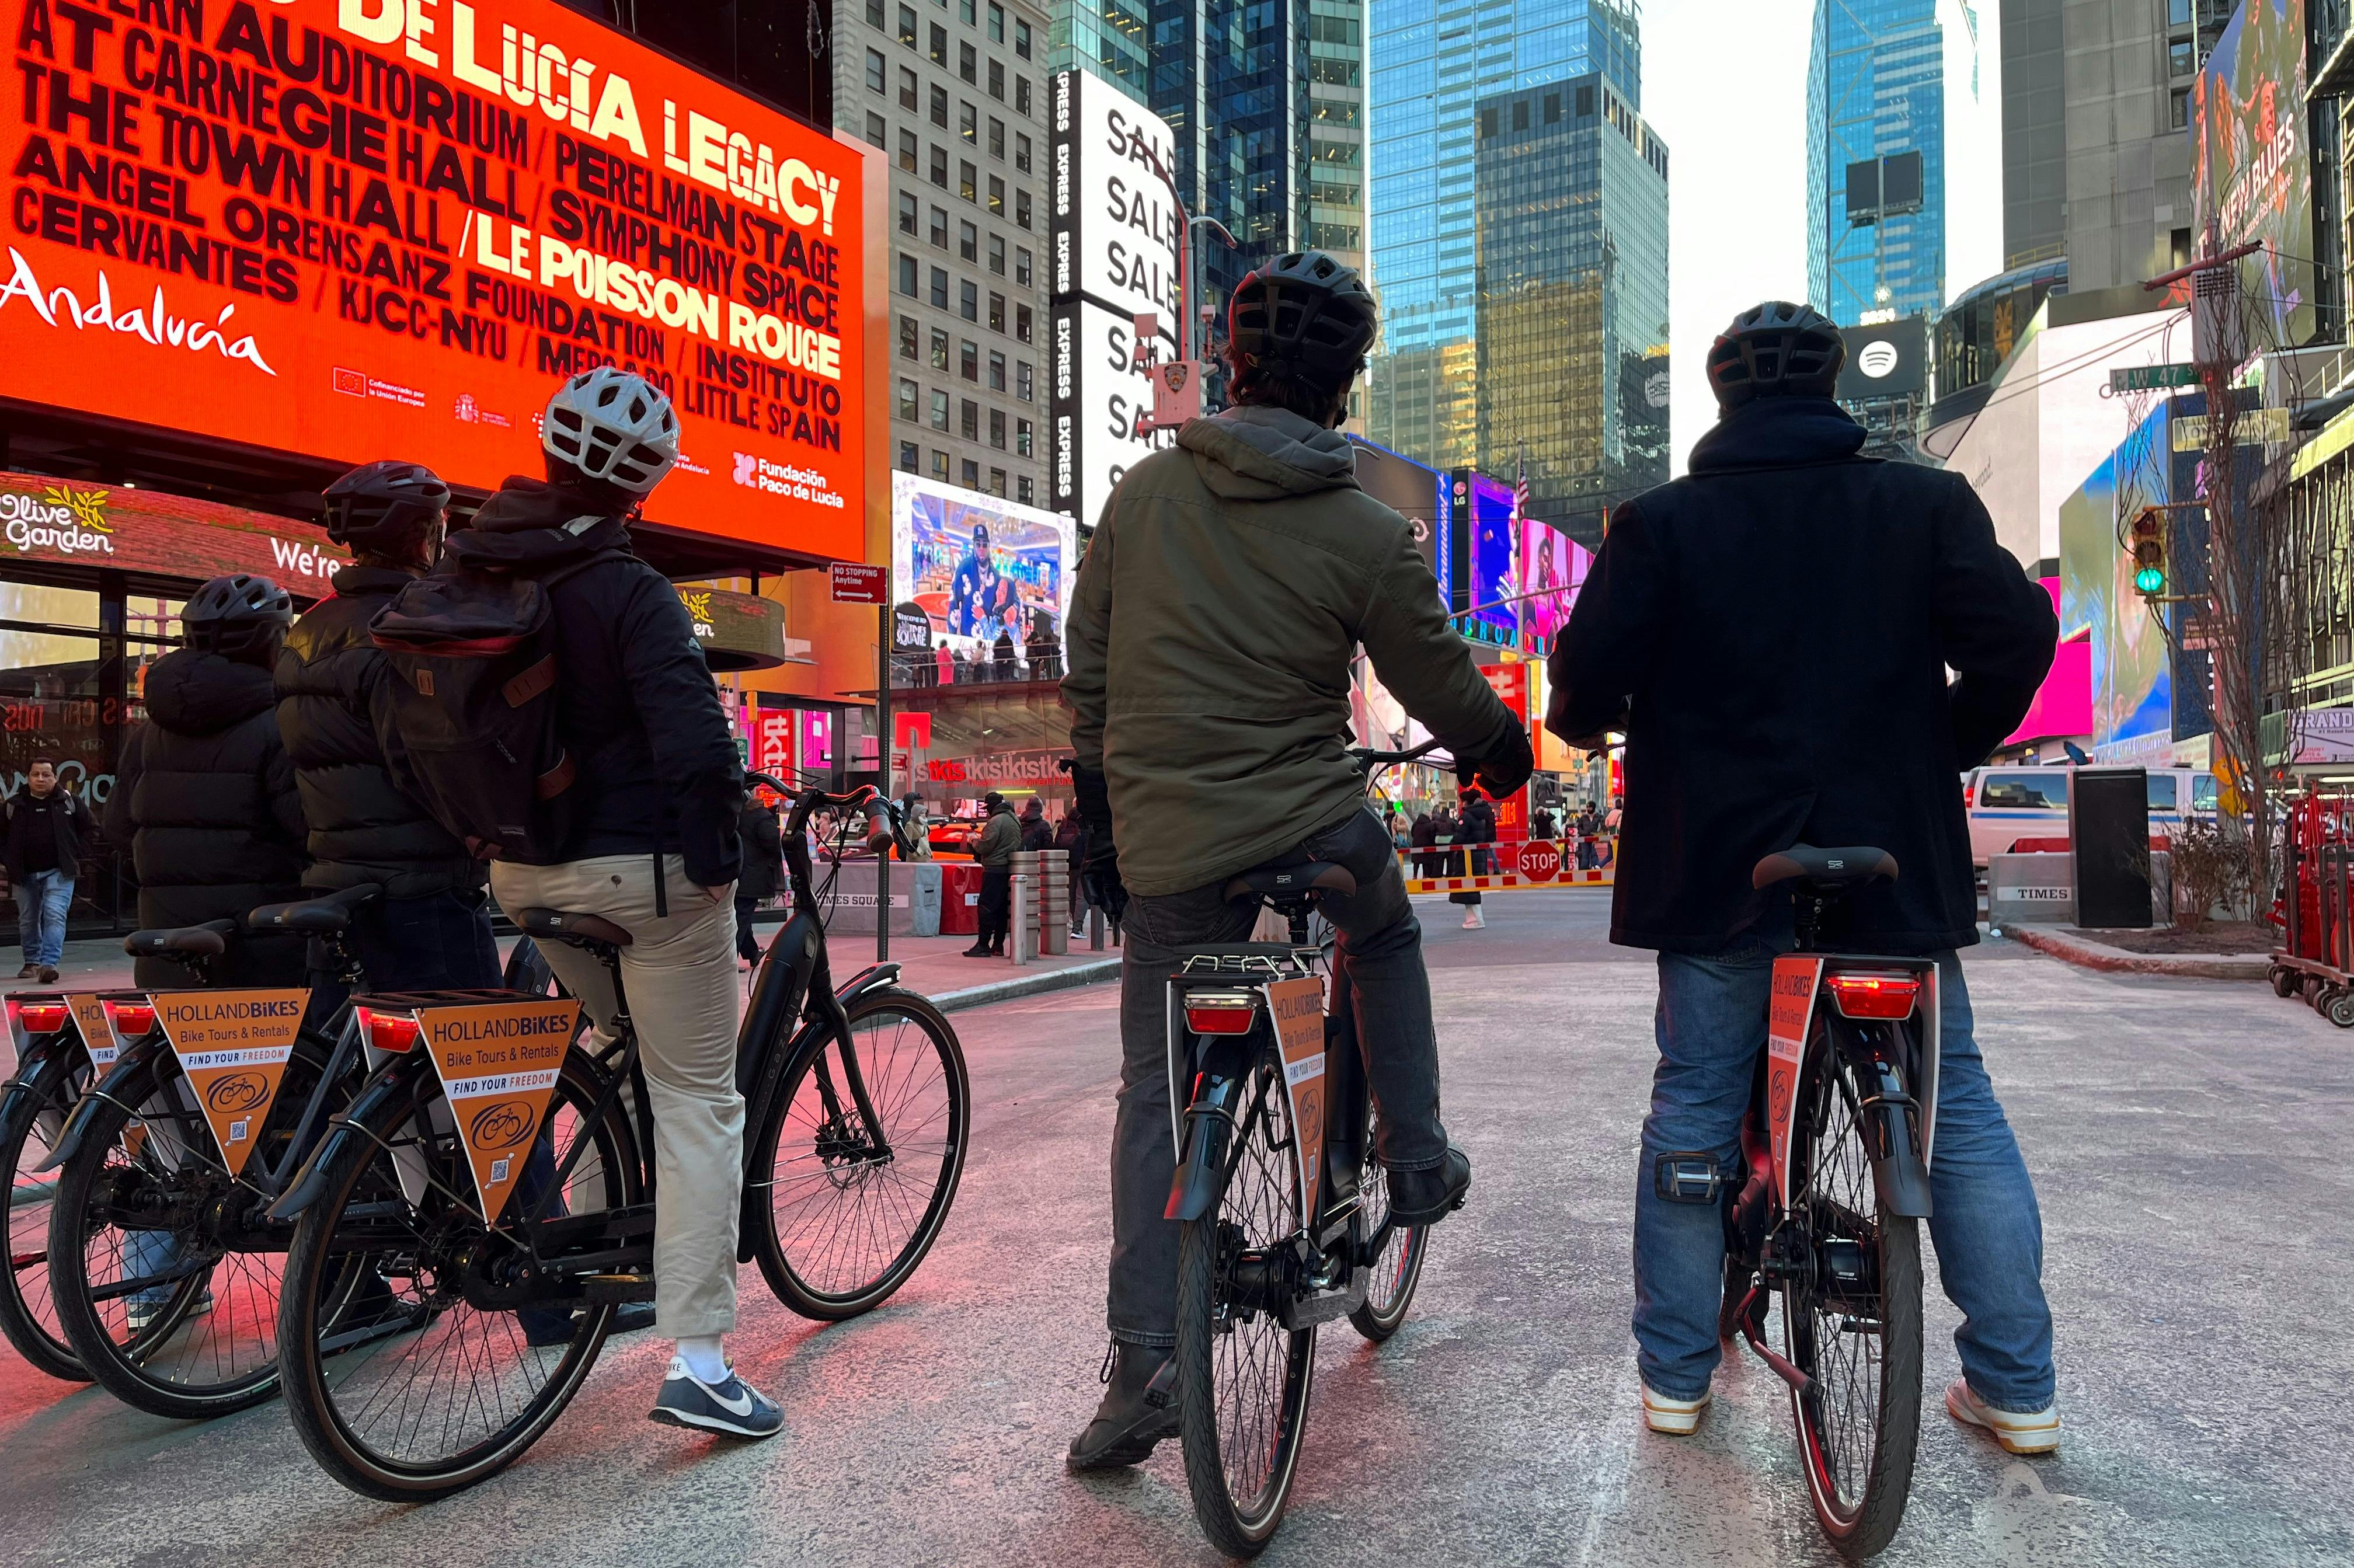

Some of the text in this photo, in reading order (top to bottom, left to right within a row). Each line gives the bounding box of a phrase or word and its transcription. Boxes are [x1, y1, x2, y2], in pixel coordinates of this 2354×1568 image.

[453, 0, 648, 158] LUCÍA
[664, 98, 840, 236] LEGACY
[215, 3, 527, 167] AUDITORIUM
[556, 133, 735, 249] PERELMAN
[741, 211, 839, 289] STAGE
[2252, 112, 2295, 201] BLUES
[18, 0, 113, 73] AT
[124, 27, 387, 174] CARNEGIE
[398, 130, 525, 224] HALL
[550, 189, 735, 294] SYMPHONY
[743, 264, 839, 334] SPACE
[1057, 142, 1070, 217] EXPRESS
[16, 58, 141, 156] THE
[155, 104, 311, 211] TOWN
[324, 162, 449, 255] HALL
[540, 235, 719, 340] POISSON
[730, 304, 841, 379] ROUGE
[12, 133, 204, 229] ANGEL
[223, 197, 451, 301] ORENSANZ
[467, 271, 664, 367] FOUNDATION
[697, 342, 841, 417] INSTITUTO
[0, 245, 277, 376] Andalucía
[13, 187, 300, 304] CERVANTES
[339, 279, 507, 361] KJCC-NYU
[684, 377, 760, 431] LITTLE
[768, 403, 841, 454] SPAIN
[1057, 316, 1071, 400] EXPRESS
[368, 378, 425, 399] Cofinanciado por
[2133, 370, 2148, 387] W
[2158, 367, 2179, 385] 47
[377, 389, 396, 401] Unión
[398, 394, 425, 407] Europea
[681, 461, 710, 475] Andalucía
[1057, 415, 1071, 497] EXPRESS
[758, 458, 827, 489] Fundación
[758, 476, 844, 509] Paco de Lucía
[1454, 497, 1466, 506] LG
[0, 493, 71, 525] Olive
[6, 518, 114, 553] Garden
[270, 536, 340, 579] We're
[834, 566, 878, 578] NO STOPPING
[834, 576, 863, 586] Anytime
[896, 630, 927, 647] SQUARE
[763, 715, 789, 780] tkts
[928, 757, 966, 782] tkts
[1521, 853, 1558, 870] STOP
[852, 896, 894, 905] SQUAE
[2018, 887, 2068, 900] TIMES
[180, 1025, 290, 1042] Bike Tours & Rentals
[768, 989, 802, 1079] Gazelle
[97, 1050, 114, 1060] FIND
[188, 1049, 285, 1066] FIND YOUR FREEDOM
[447, 1044, 559, 1067] Bike Tours & Rentals
[453, 1072, 553, 1095] FIND YOUR FREEDOM
[1290, 1065, 1299, 1079] FIND
[1299, 1062, 1308, 1077] YOUR
